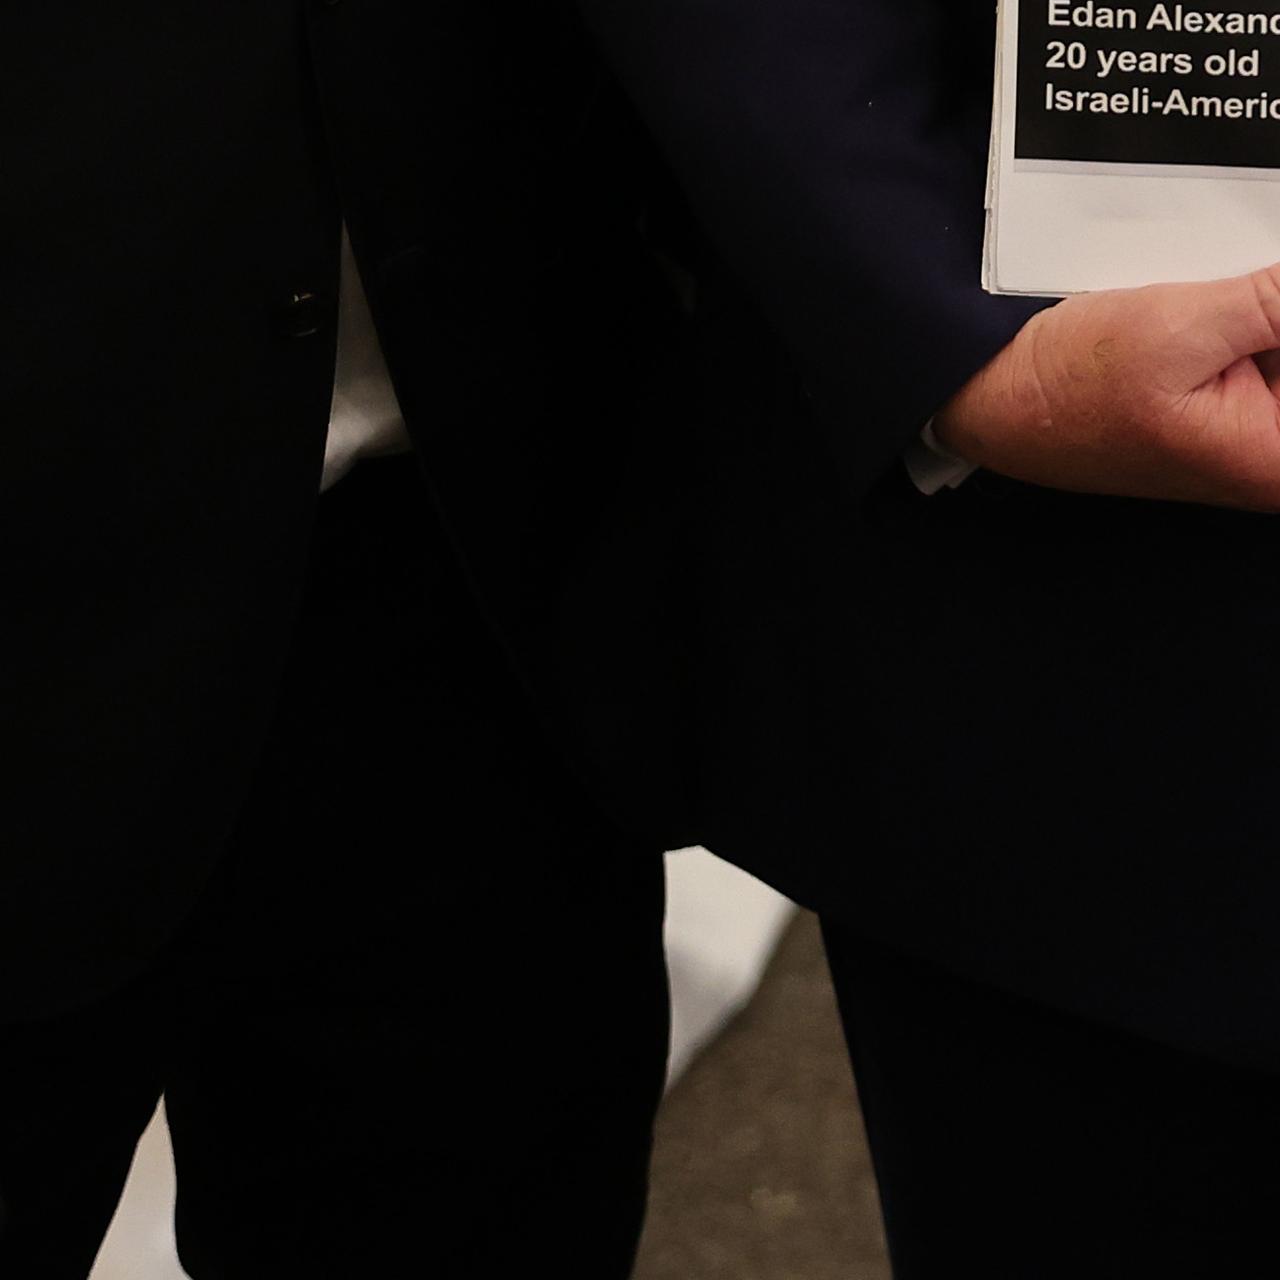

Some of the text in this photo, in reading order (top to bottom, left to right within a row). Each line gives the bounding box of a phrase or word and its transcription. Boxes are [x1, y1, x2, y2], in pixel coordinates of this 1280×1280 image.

[1045, 41, 1259, 78] 20 years old
